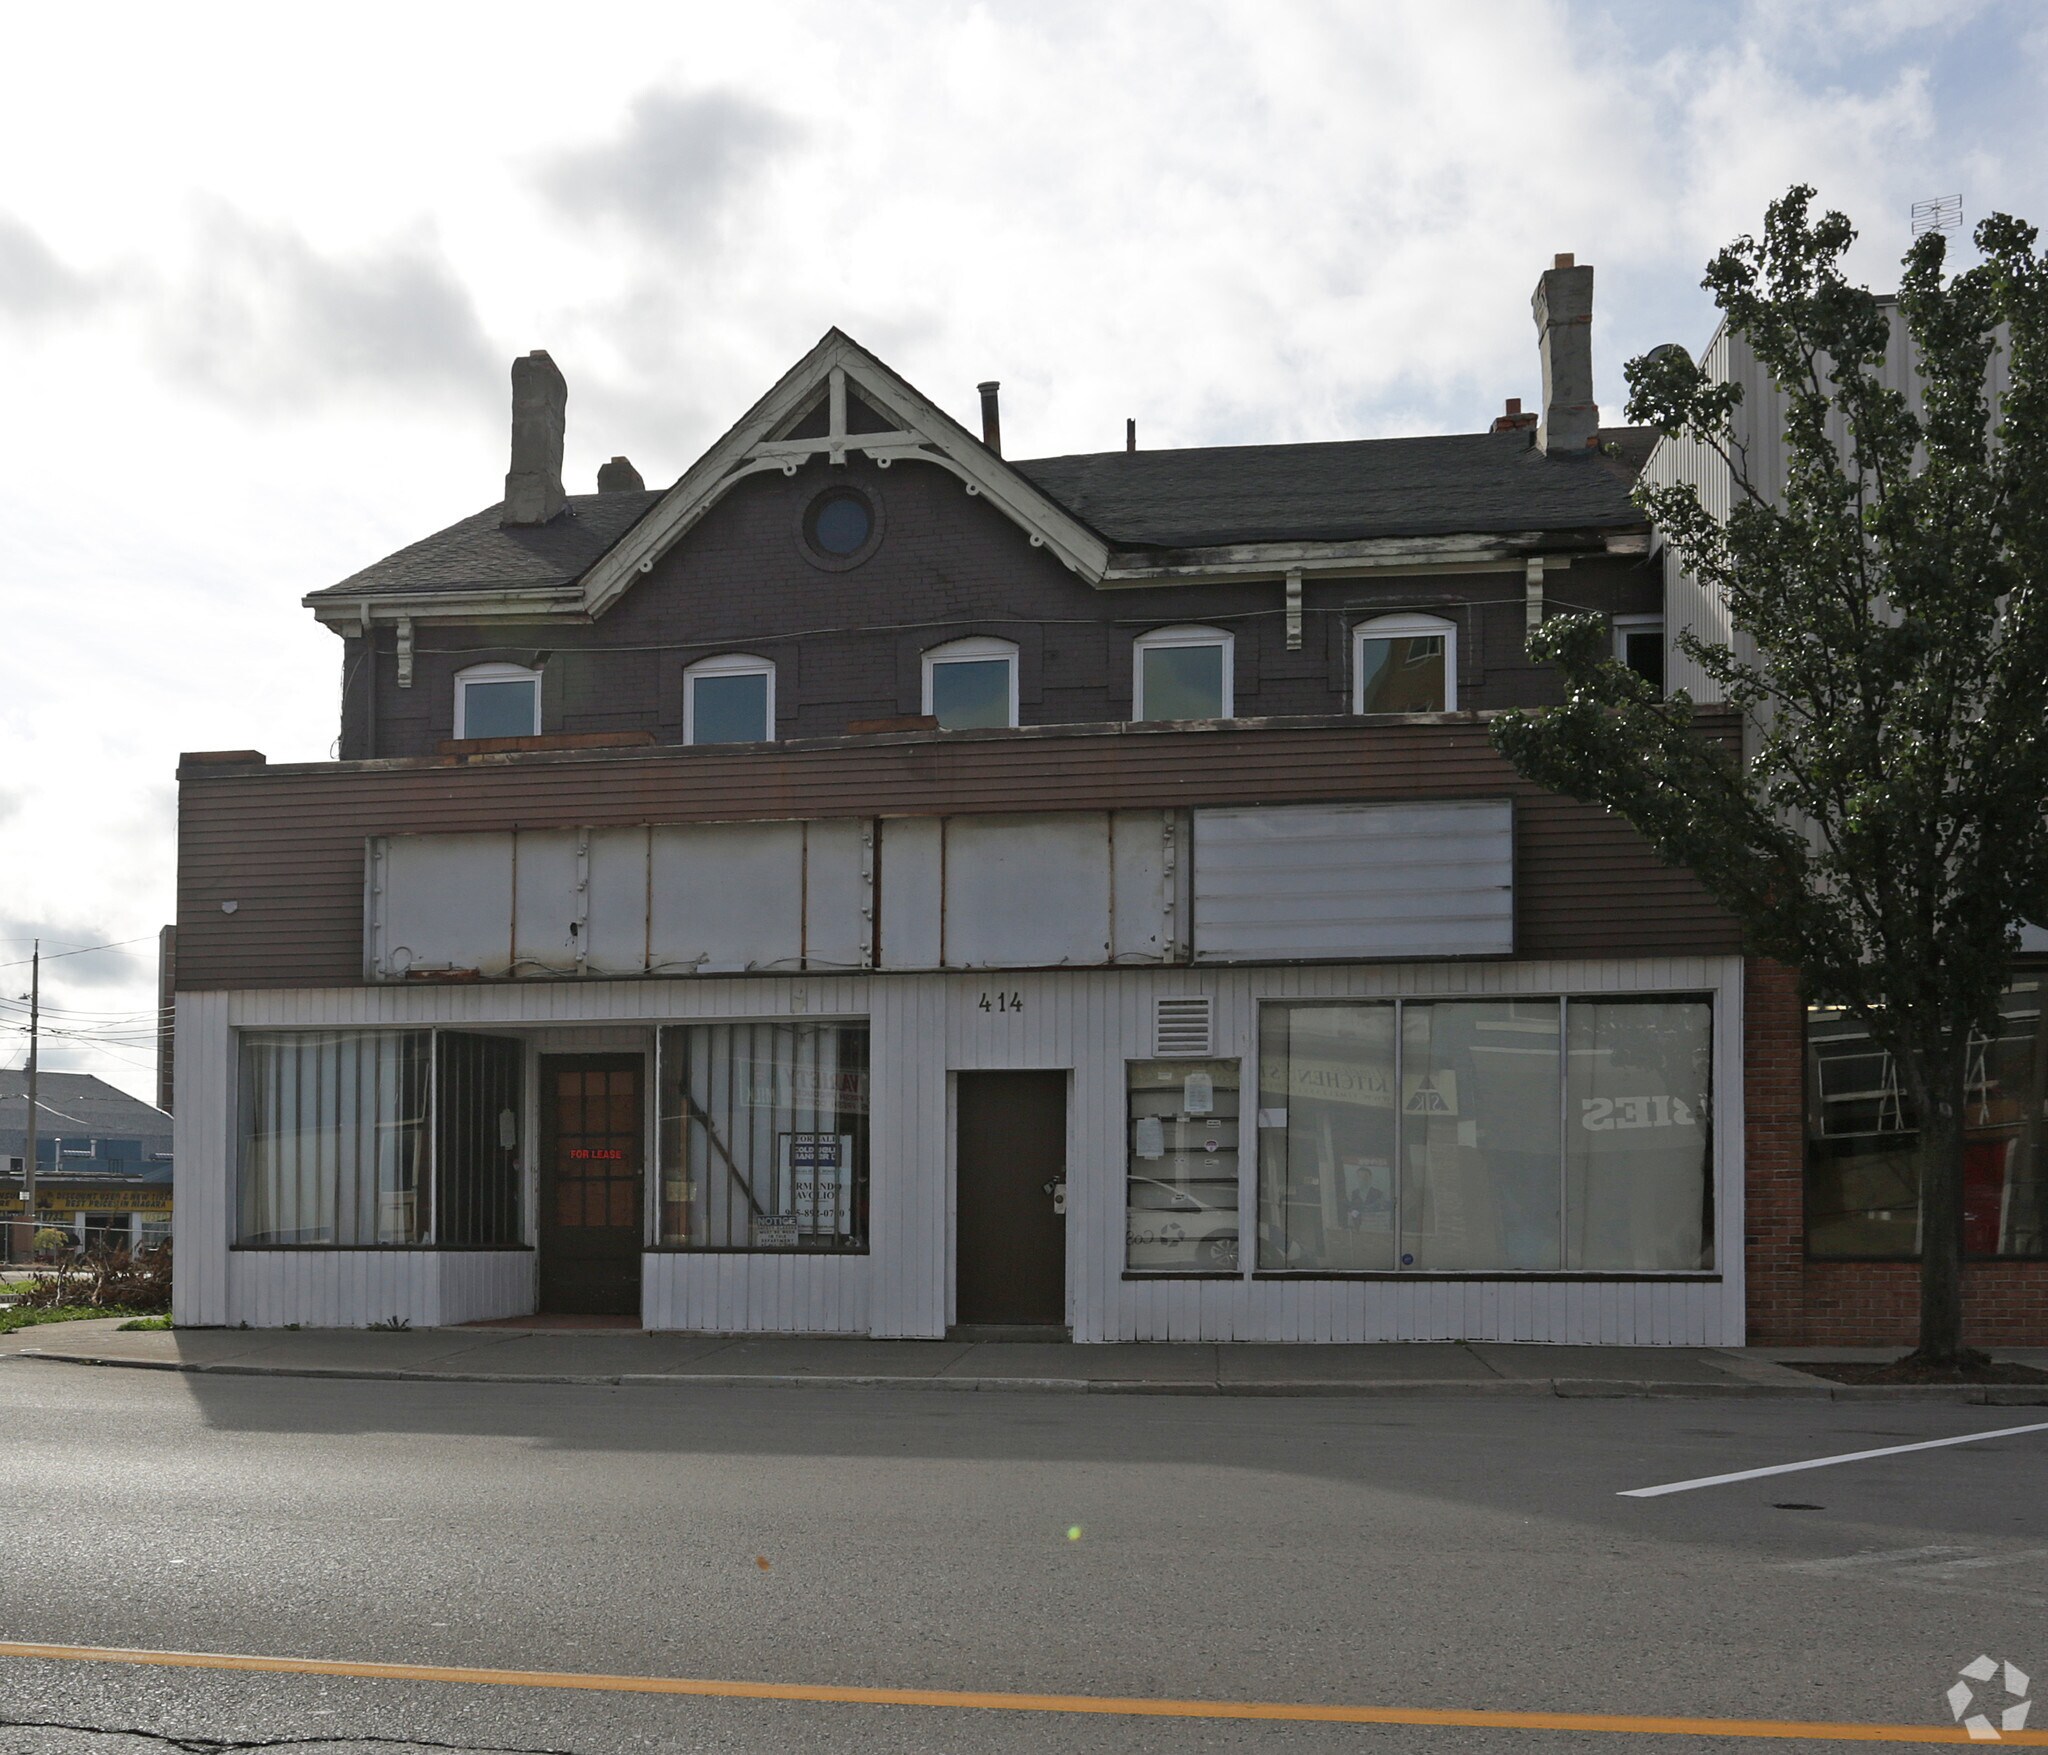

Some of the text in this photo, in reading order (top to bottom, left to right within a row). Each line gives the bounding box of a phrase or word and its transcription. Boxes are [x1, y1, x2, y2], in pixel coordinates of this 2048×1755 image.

[979, 992, 1023, 1012] 414
[570, 1150, 623, 1159] FOR LEASE
[791, 1182, 842, 1190] RMNDO
[130, 1200, 166, 1208] NIAGARA
[785, 1209, 845, 1217] 95-89-070
[757, 1217, 797, 1226] NOTICE
